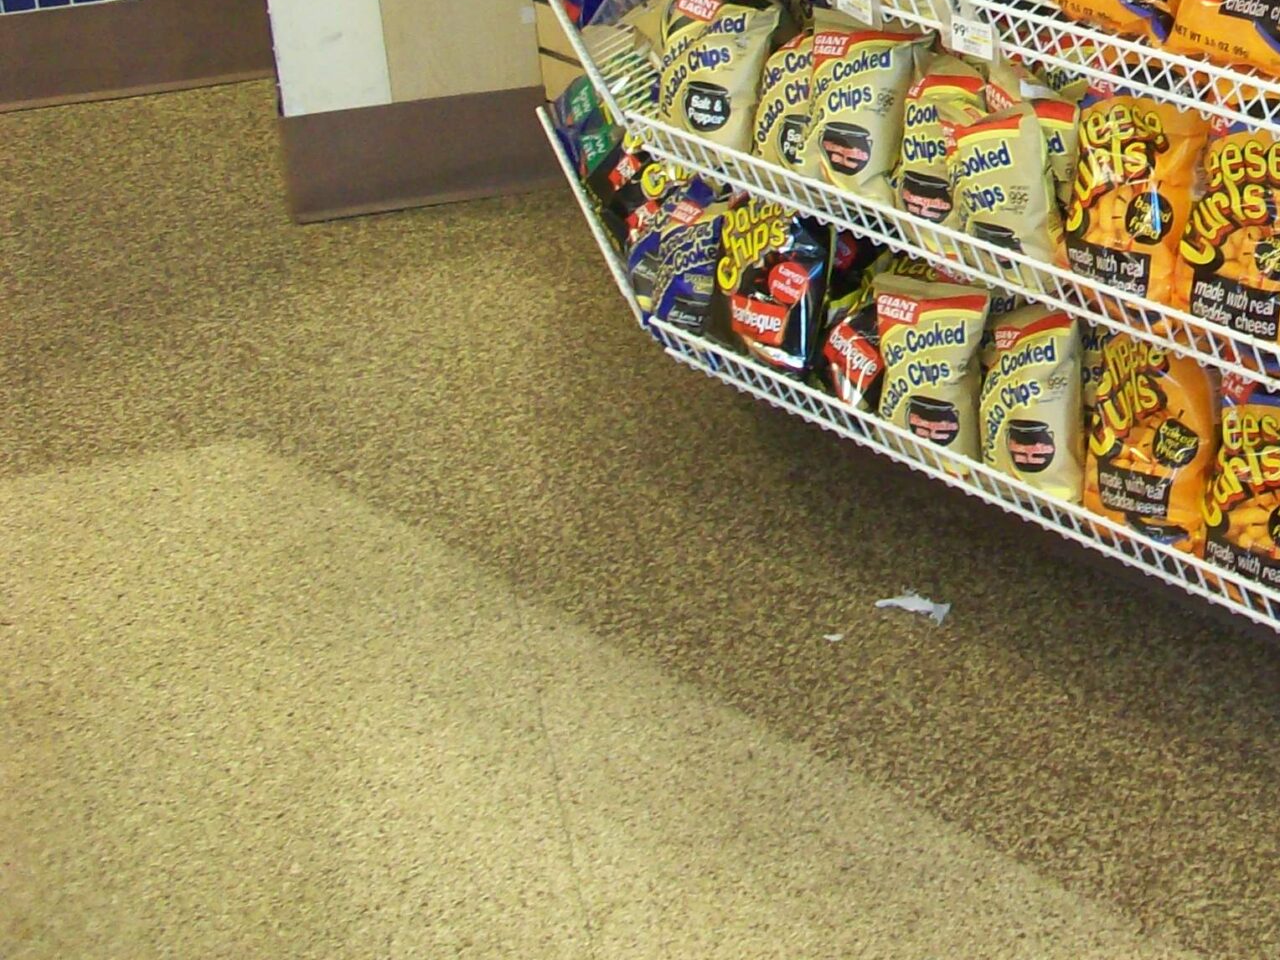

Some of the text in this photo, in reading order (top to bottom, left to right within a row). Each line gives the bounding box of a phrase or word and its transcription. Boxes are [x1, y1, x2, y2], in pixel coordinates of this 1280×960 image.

[678, 0, 715, 19] EAGLE
[815, 33, 849, 46] GIANT
[1189, 29, 1202, 43] WT
[688, 46, 731, 73] Chips
[814, 44, 845, 56] EAGLE
[690, 95, 711, 109] Salt
[828, 84, 872, 112] Chips
[688, 108, 725, 125] Pepper
[903, 137, 947, 162] Chips
[717, 219, 786, 291] Chips
[1069, 246, 1144, 277] made with real
[877, 294, 918, 313] GIANT
[1195, 280, 1275, 316] made with real
[732, 300, 782, 331] barbeque
[877, 306, 913, 322] EAGLE
[1192, 298, 1276, 337] cheddar cheese
[829, 330, 877, 375] barbeque
[907, 359, 950, 389] Chips
[1000, 379, 1040, 410] Chips
[1089, 371, 1158, 457] Curls
[1100, 471, 1123, 489] made
[1206, 540, 1236, 564] made
[1237, 554, 1261, 573] with
